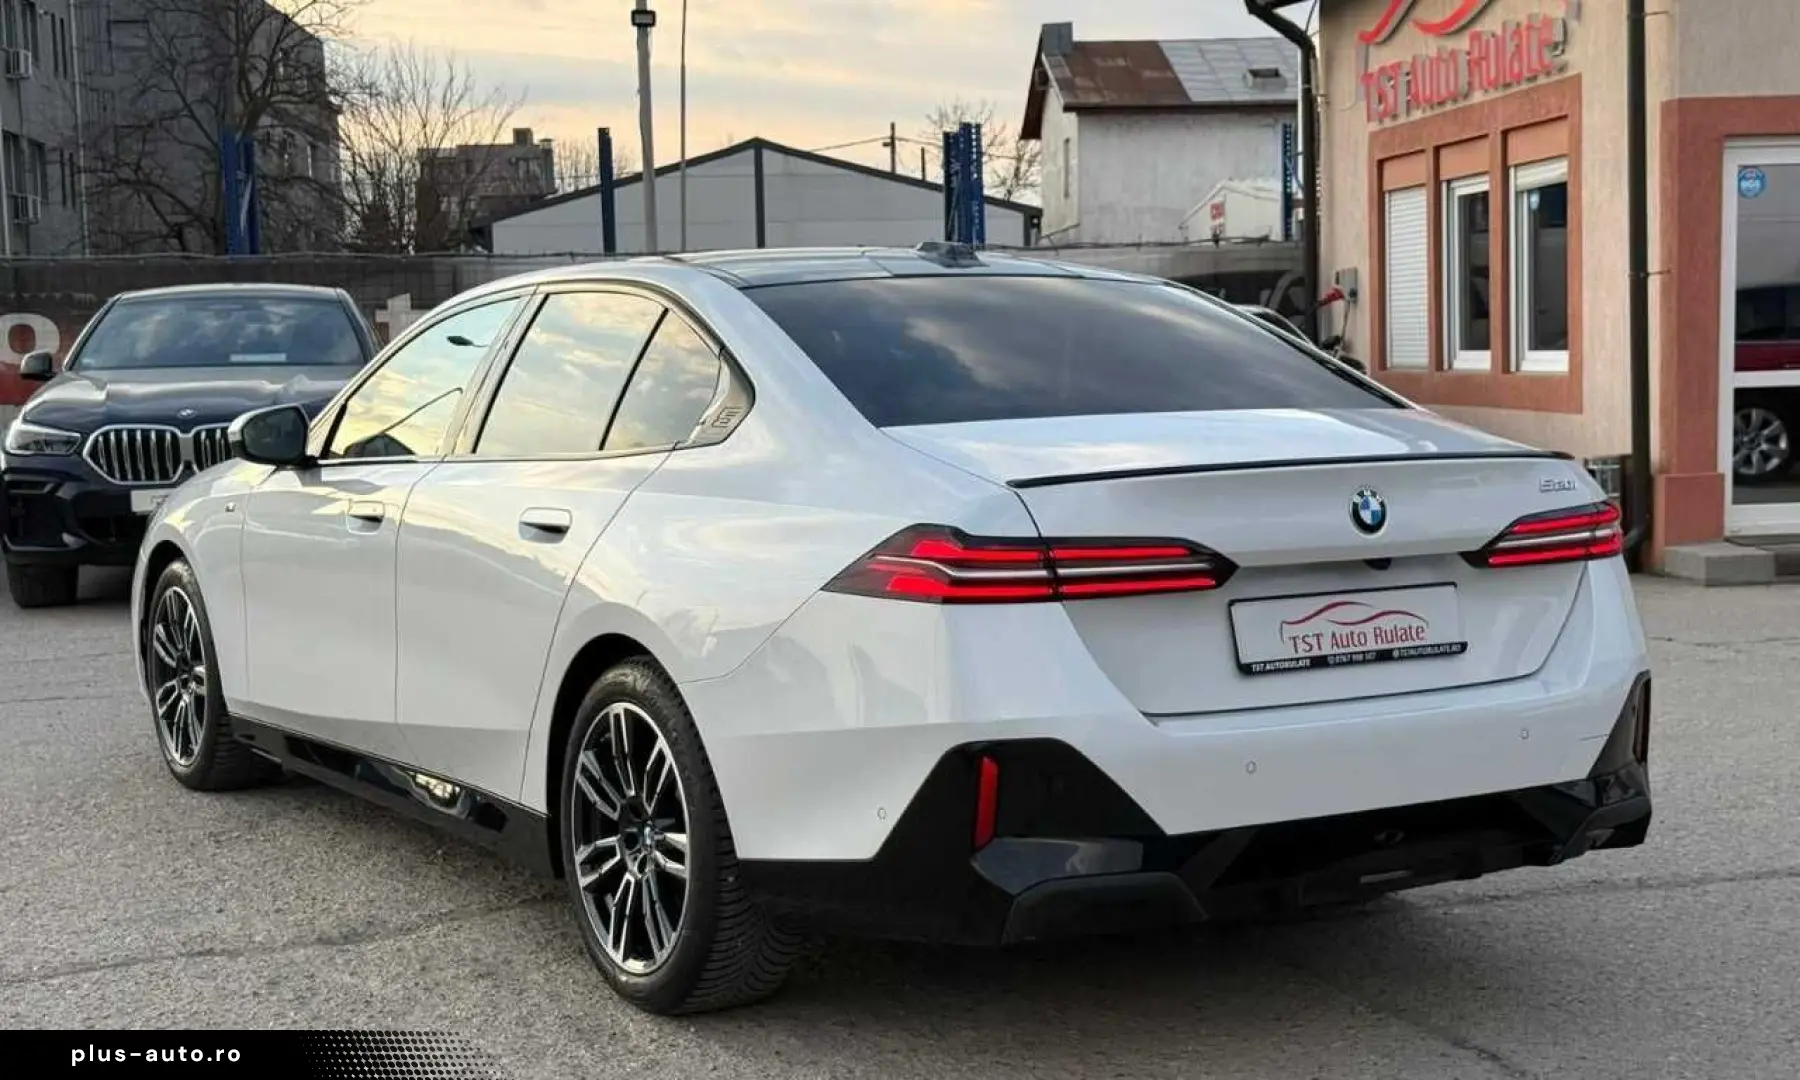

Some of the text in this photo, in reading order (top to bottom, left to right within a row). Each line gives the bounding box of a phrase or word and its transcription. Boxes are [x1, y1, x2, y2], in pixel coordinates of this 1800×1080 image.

[1361, 14, 1560, 124] TST Auto Rulate
[1288, 623, 1426, 654] TST Auto Rulate
